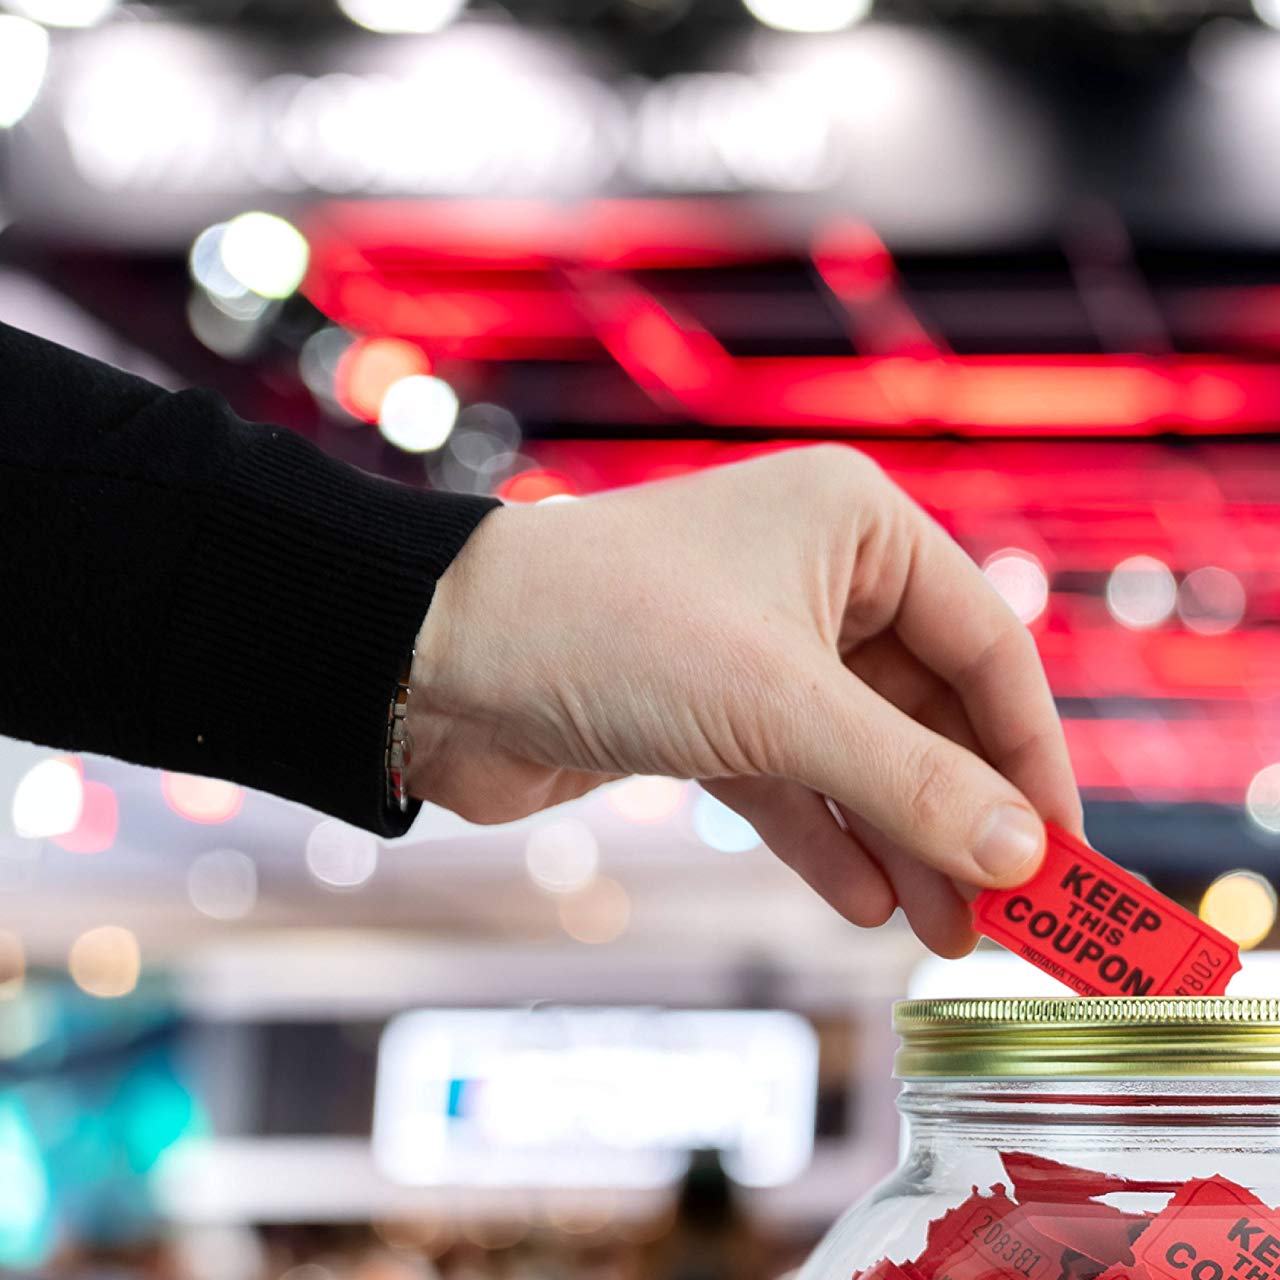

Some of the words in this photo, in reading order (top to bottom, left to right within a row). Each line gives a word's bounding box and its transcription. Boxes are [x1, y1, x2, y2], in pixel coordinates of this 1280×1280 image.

[1060, 864, 1162, 934] KEEP
[1067, 901, 1124, 947] THIS
[1004, 895, 1155, 996] COUPON
[1020, 944, 1065, 978] INDIANA
[972, 1214, 1042, 1279] 208381
